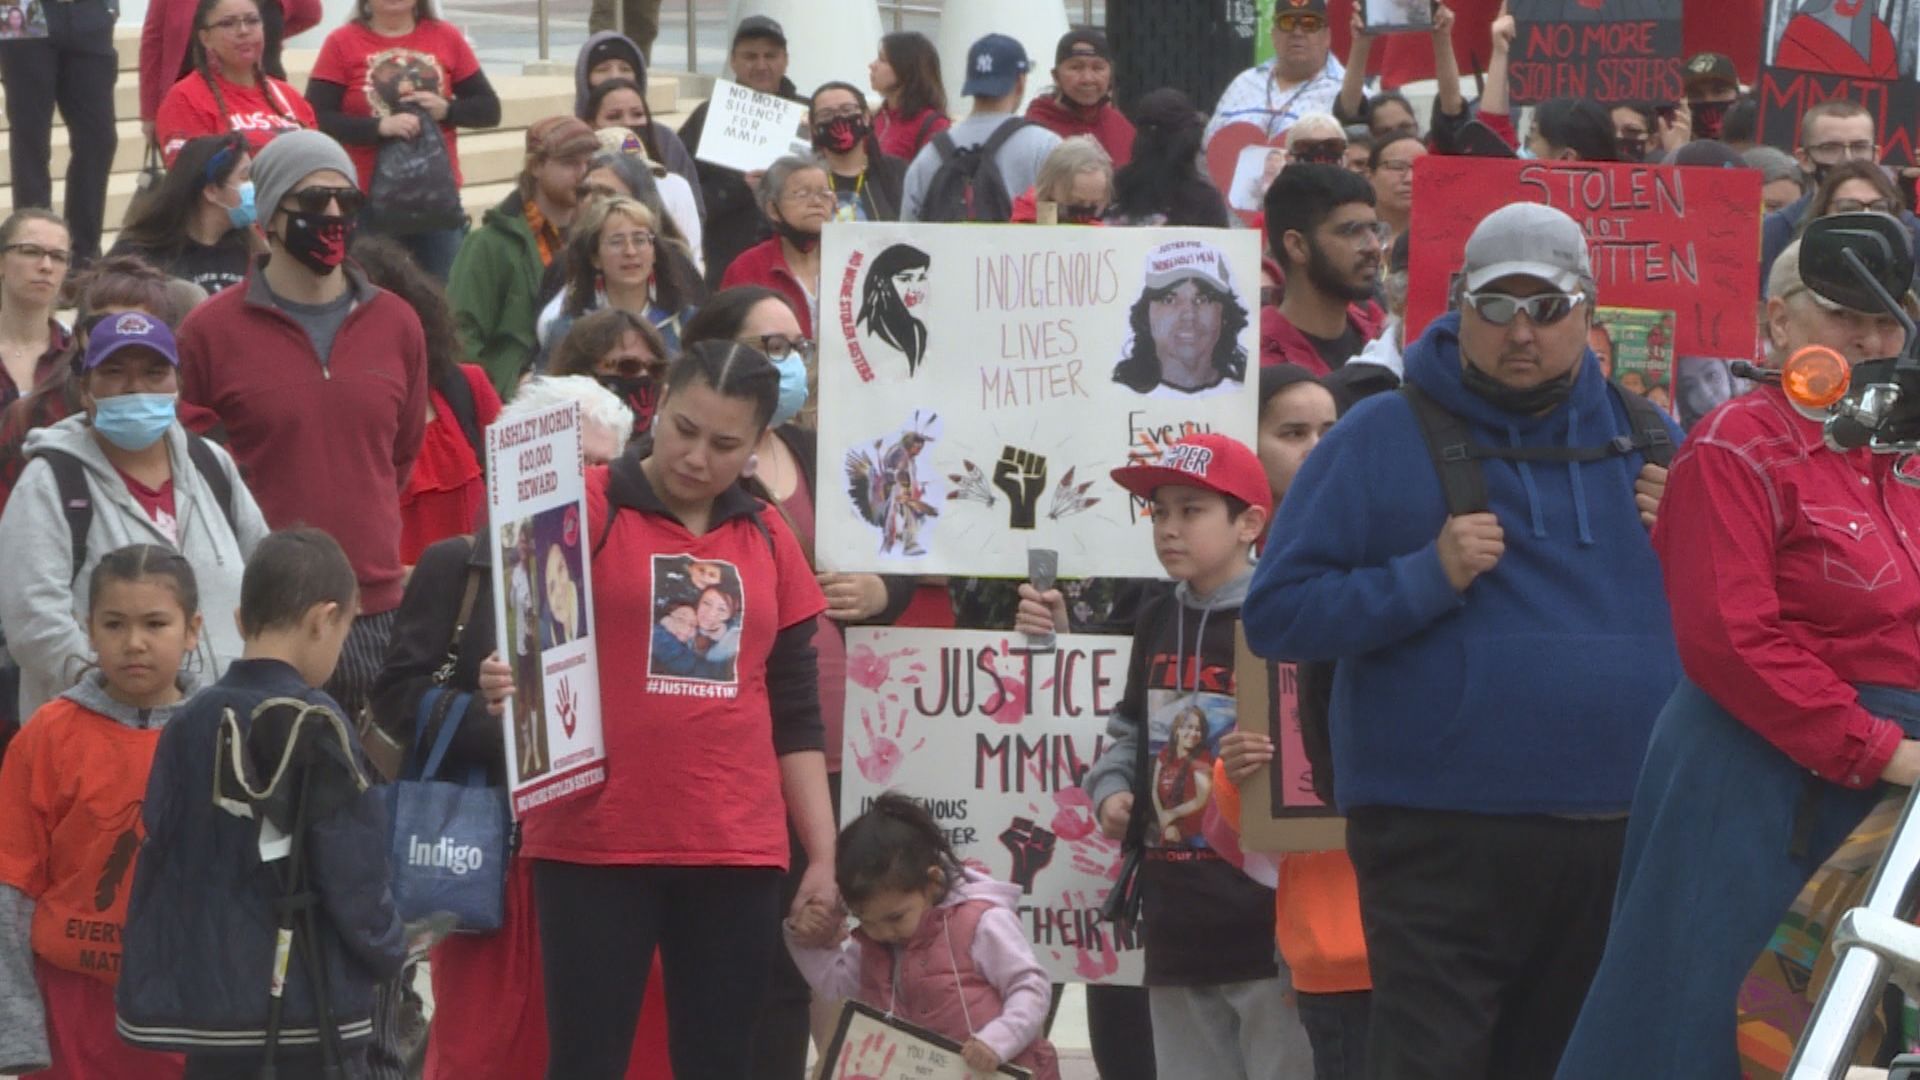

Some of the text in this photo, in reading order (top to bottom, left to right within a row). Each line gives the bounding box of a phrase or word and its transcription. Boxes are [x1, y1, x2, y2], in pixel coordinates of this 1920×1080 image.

[1526, 21, 1659, 59] NO MORE
[1509, 59, 1589, 101] STOLEN
[1594, 57, 1686, 101] SISTERS
[725, 98, 784, 125] SILENCE
[729, 86, 789, 113] NO MORE
[723, 125, 768, 147] MMIP
[732, 114, 760, 131] FOR
[1519, 164, 1686, 219] STOLEN
[1577, 218, 1633, 241] NOT
[848, 249, 865, 268] NO
[976, 249, 1119, 312] INDIGENOUS
[839, 301, 856, 341] STOLEN
[1001, 319, 1078, 360] LIVES
[980, 359, 1090, 411] MATTER
[499, 406, 574, 450] ASHLEY MORIN
[518, 443, 553, 475] $20,000
[517, 471, 559, 502] REWARD
[914, 647, 1117, 717] JUSTICE
[975, 733, 1103, 793] MMIW
